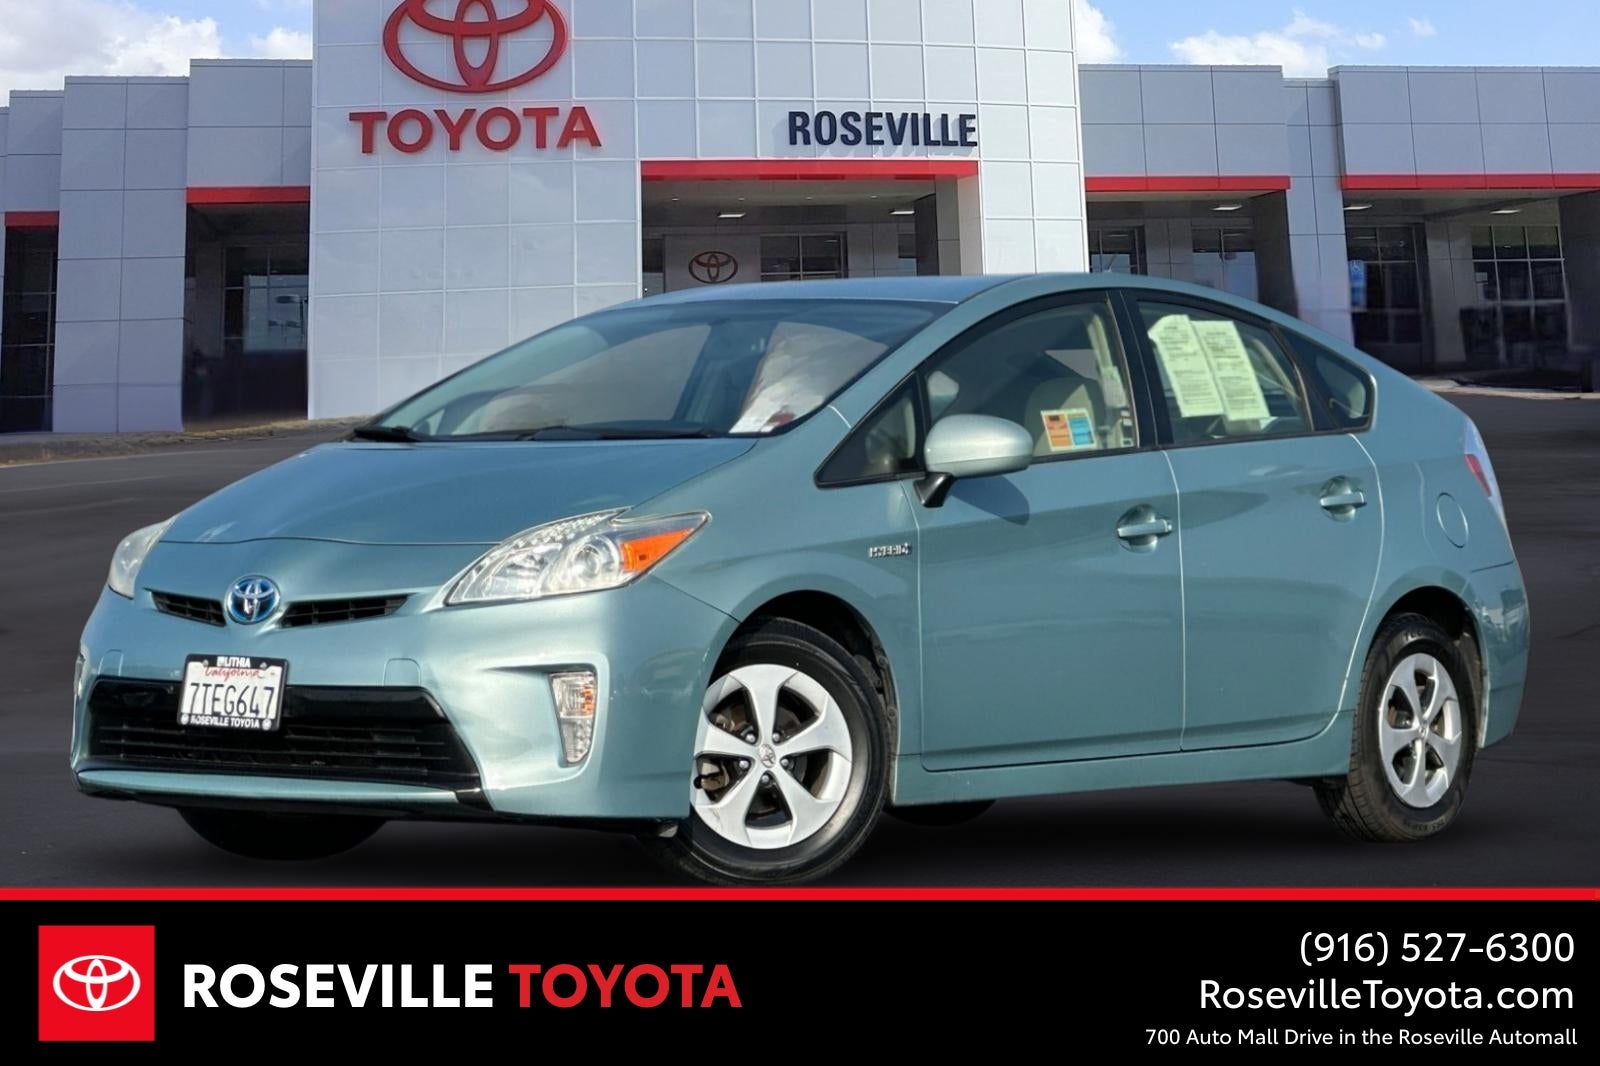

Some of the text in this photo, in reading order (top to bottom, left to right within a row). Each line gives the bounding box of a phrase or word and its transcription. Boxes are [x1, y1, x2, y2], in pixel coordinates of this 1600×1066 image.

[349, 107, 602, 154] TOYOTA
[788, 111, 978, 147] ROSEVILLE
[224, 656, 251, 667] LITHIA
[190, 682, 275, 718] 7TEG647
[190, 715, 261, 729] ROSEVILLE TOYOTA
